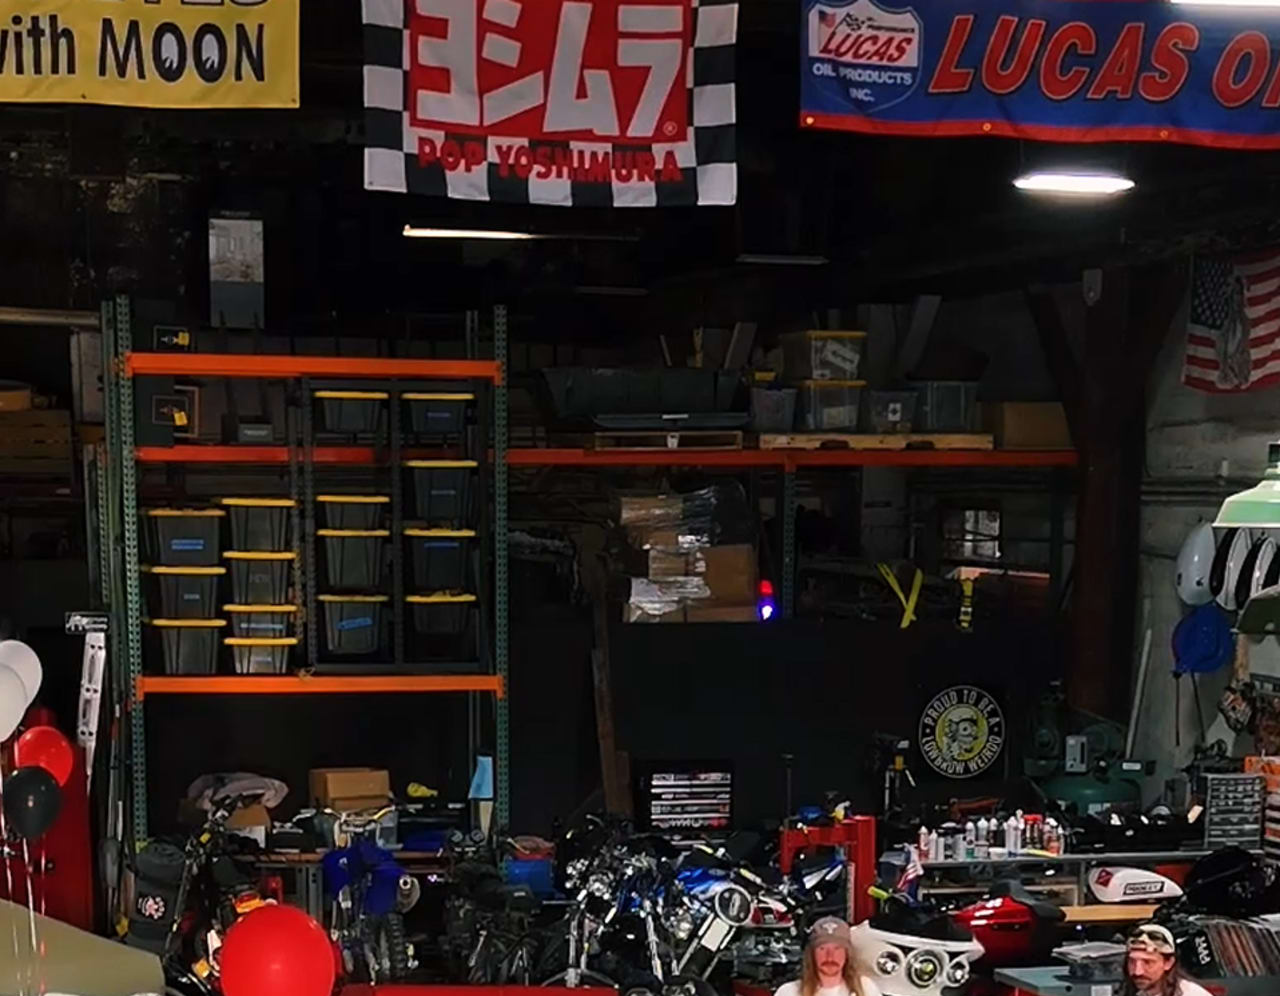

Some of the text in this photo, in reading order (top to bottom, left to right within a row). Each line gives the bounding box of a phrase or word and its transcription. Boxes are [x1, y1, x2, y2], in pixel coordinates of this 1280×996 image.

[98, 17, 266, 83] MOON
[819, 33, 913, 62] LUCAS
[928, 14, 1200, 101] LUCAS
[812, 62, 913, 85] OIL PRODUCTS
[417, 137, 684, 183] POP YOSHIMURA
[923, 689, 1000, 727] PROUD TO BE A
[922, 734, 1002, 775] LOWBROW WEIRDO
